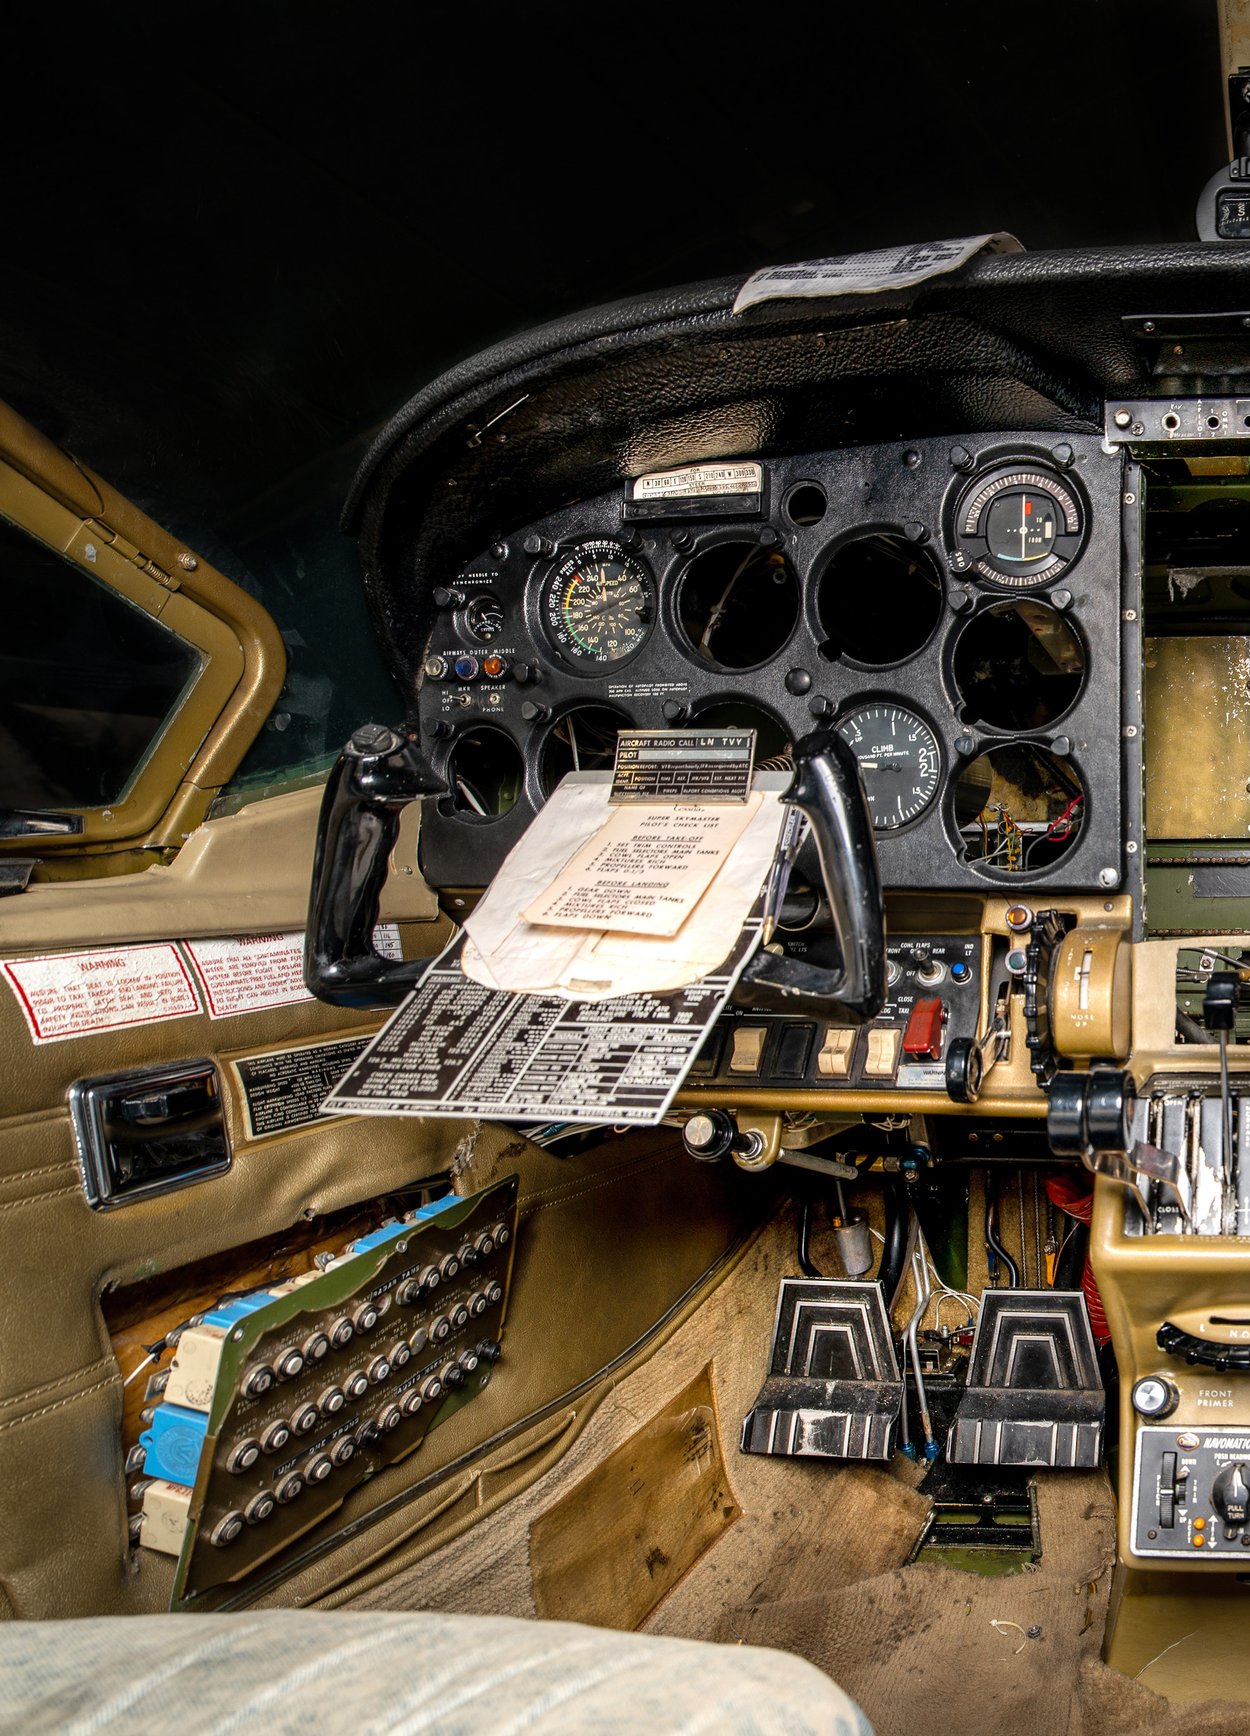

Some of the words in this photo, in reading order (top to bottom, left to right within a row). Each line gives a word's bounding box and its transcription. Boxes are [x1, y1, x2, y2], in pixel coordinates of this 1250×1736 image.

[955, 551, 965, 567] OBS
[559, 559, 574, 574] PRESS
[578, 585, 590, 593] 220
[624, 628, 636, 636] 100
[700, 738, 714, 746] LN
[722, 738, 742, 746] TVY
[871, 744, 894, 754] CLIMB
[619, 750, 638, 759] PILOT
[237, 933, 284, 946] WARNING
[77, 958, 126, 972] WARNING
[1163, 1099, 1183, 1107] OPEN
[372, 1278, 397, 1299] RADAR
[1199, 1389, 1232, 1398] FRONT
[1197, 1399, 1234, 1408] PRIMER
[277, 1458, 297, 1475] UHF
